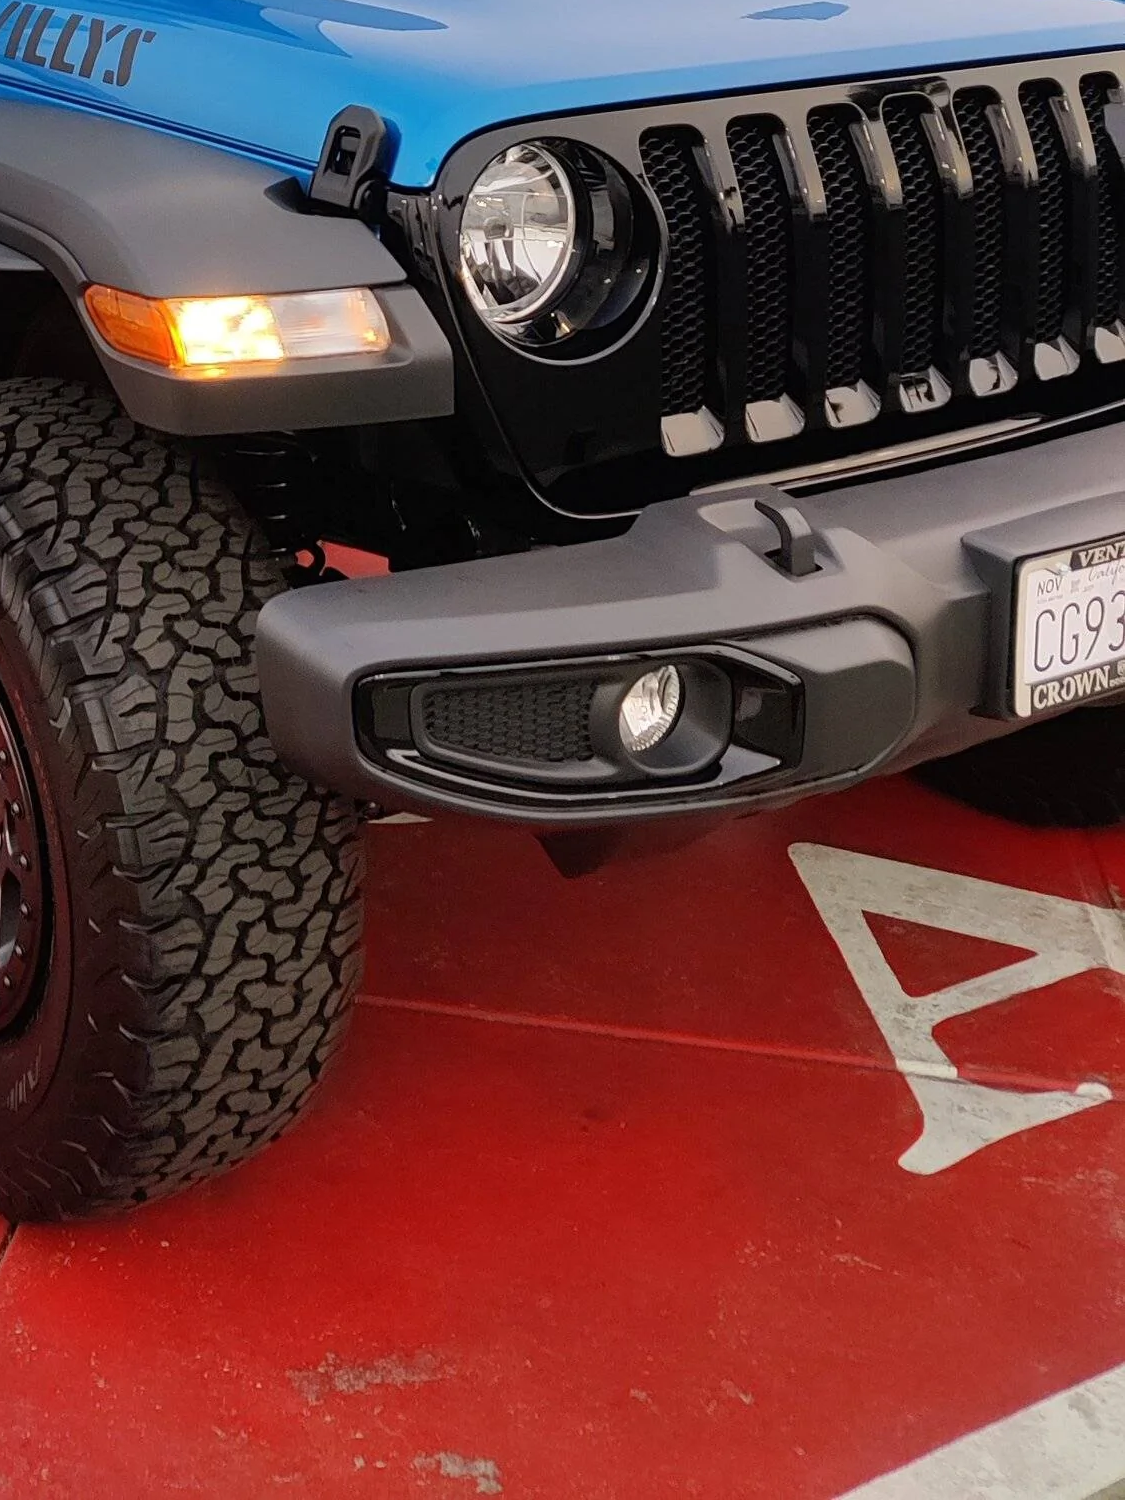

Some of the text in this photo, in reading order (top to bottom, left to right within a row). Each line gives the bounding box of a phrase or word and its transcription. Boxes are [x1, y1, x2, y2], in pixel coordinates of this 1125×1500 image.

[1036, 576, 1063, 597] NOV
[1033, 590, 1125, 673] CG93
[1033, 664, 1111, 710] CROWN
